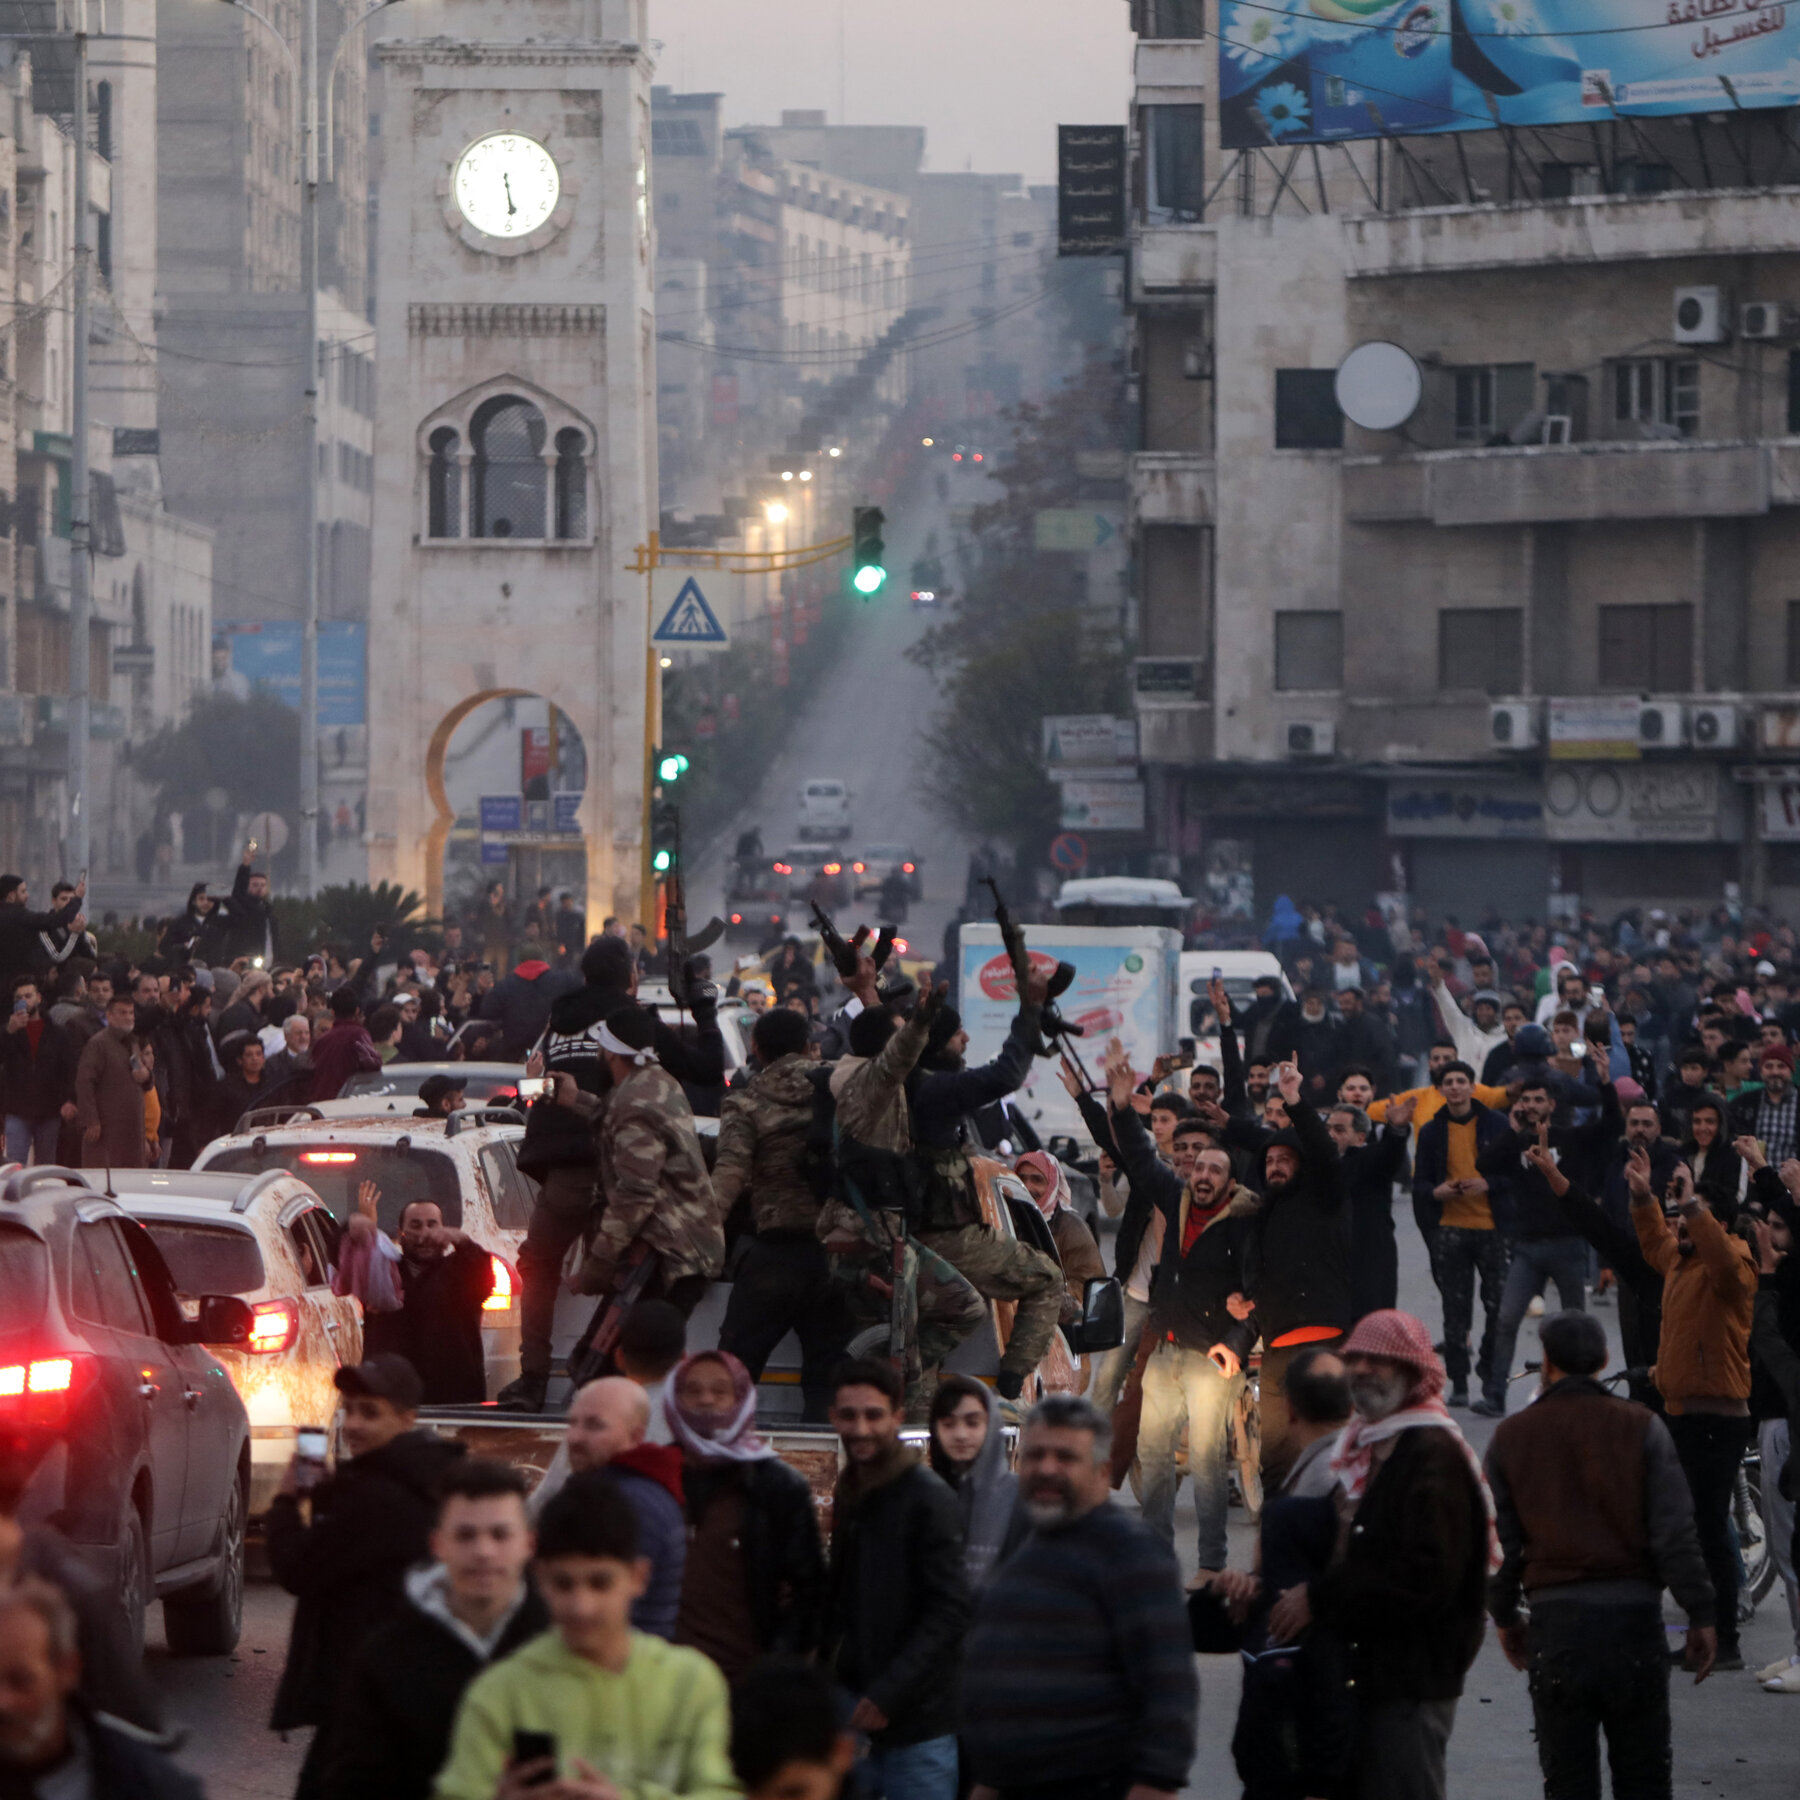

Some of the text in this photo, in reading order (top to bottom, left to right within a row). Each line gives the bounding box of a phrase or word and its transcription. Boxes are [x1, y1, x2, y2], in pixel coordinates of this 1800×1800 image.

[1691, 5, 1786, 59] للغسيل
[501, 138, 516, 152] 12
[466, 159, 479, 172] 10
[540, 159, 548, 172] 2
[548, 179, 555, 192] 3
[540, 201, 547, 211] 4
[504, 218, 512, 232] 6
